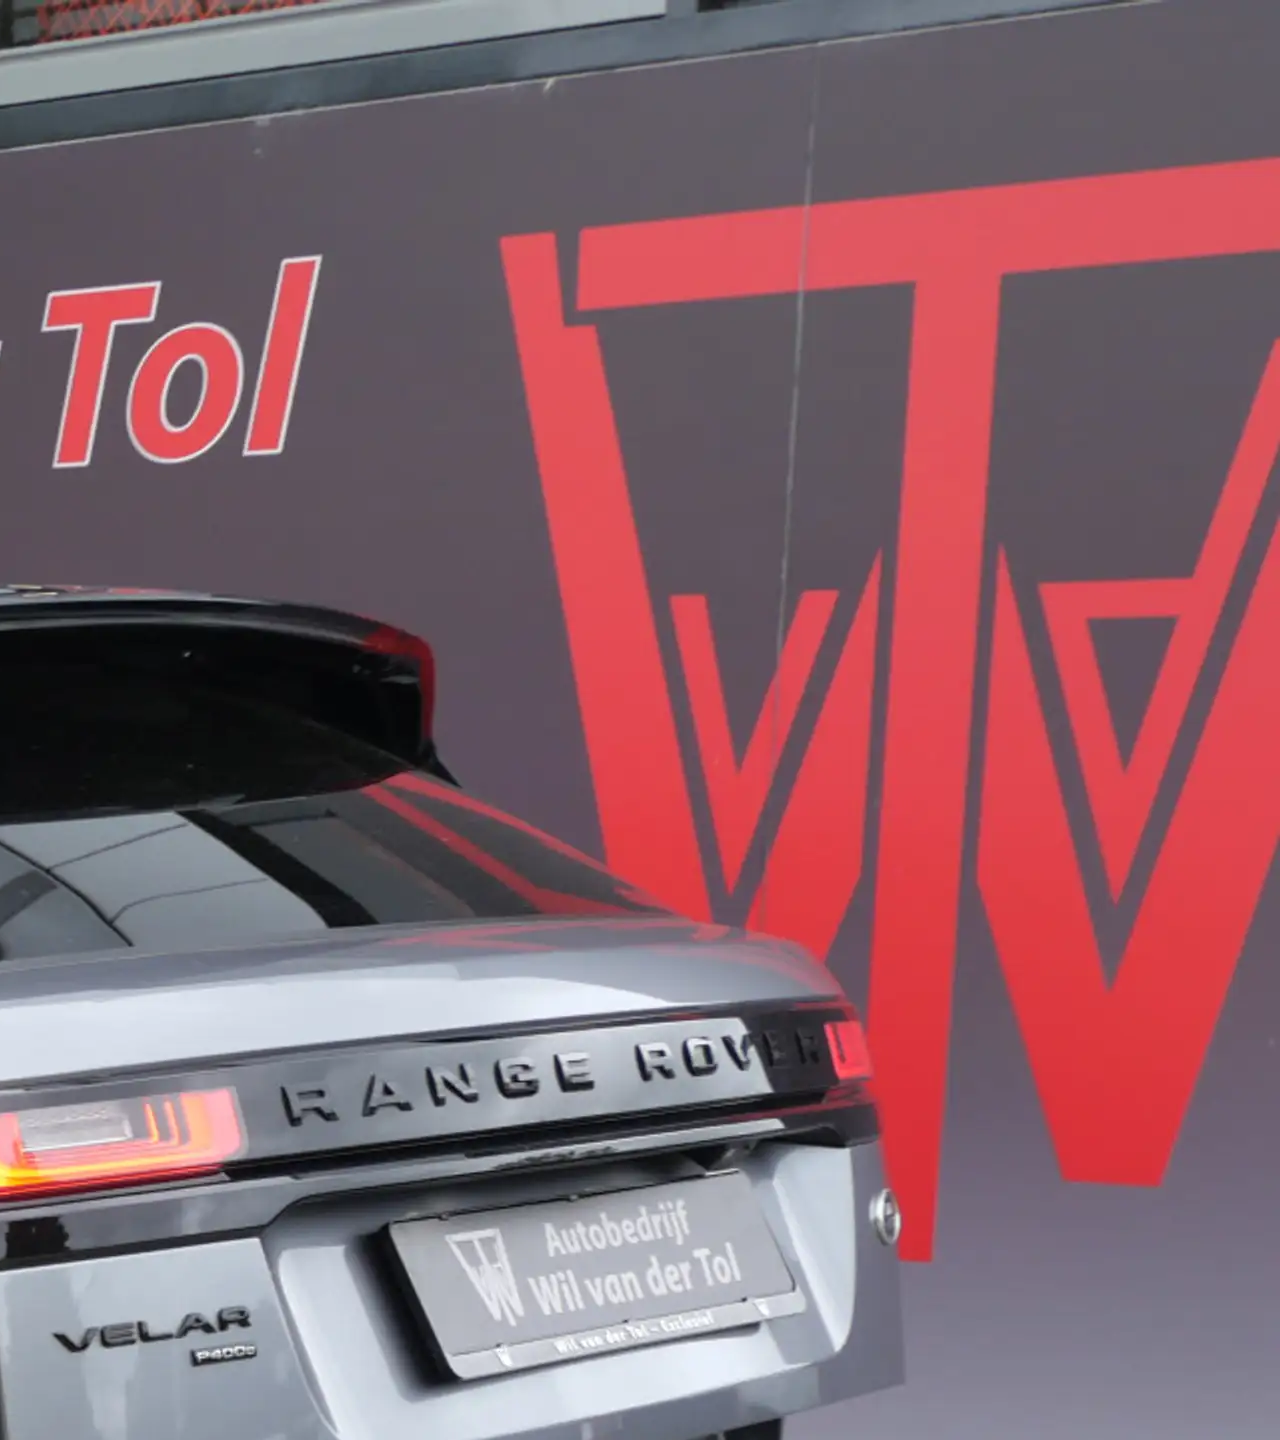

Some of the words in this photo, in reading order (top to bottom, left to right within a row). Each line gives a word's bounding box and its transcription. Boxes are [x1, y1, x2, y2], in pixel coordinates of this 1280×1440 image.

[41, 254, 323, 470] Tol
[280, 1051, 596, 1128] RANGE
[634, 1027, 822, 1082] ROVER
[544, 1199, 691, 1258] Autobedrijf
[527, 1269, 584, 1317] Wil
[584, 1271, 642, 1307] van
[645, 1254, 695, 1298] der
[692, 1241, 742, 1287] Tol
[52, 1305, 253, 1354] VELAR
